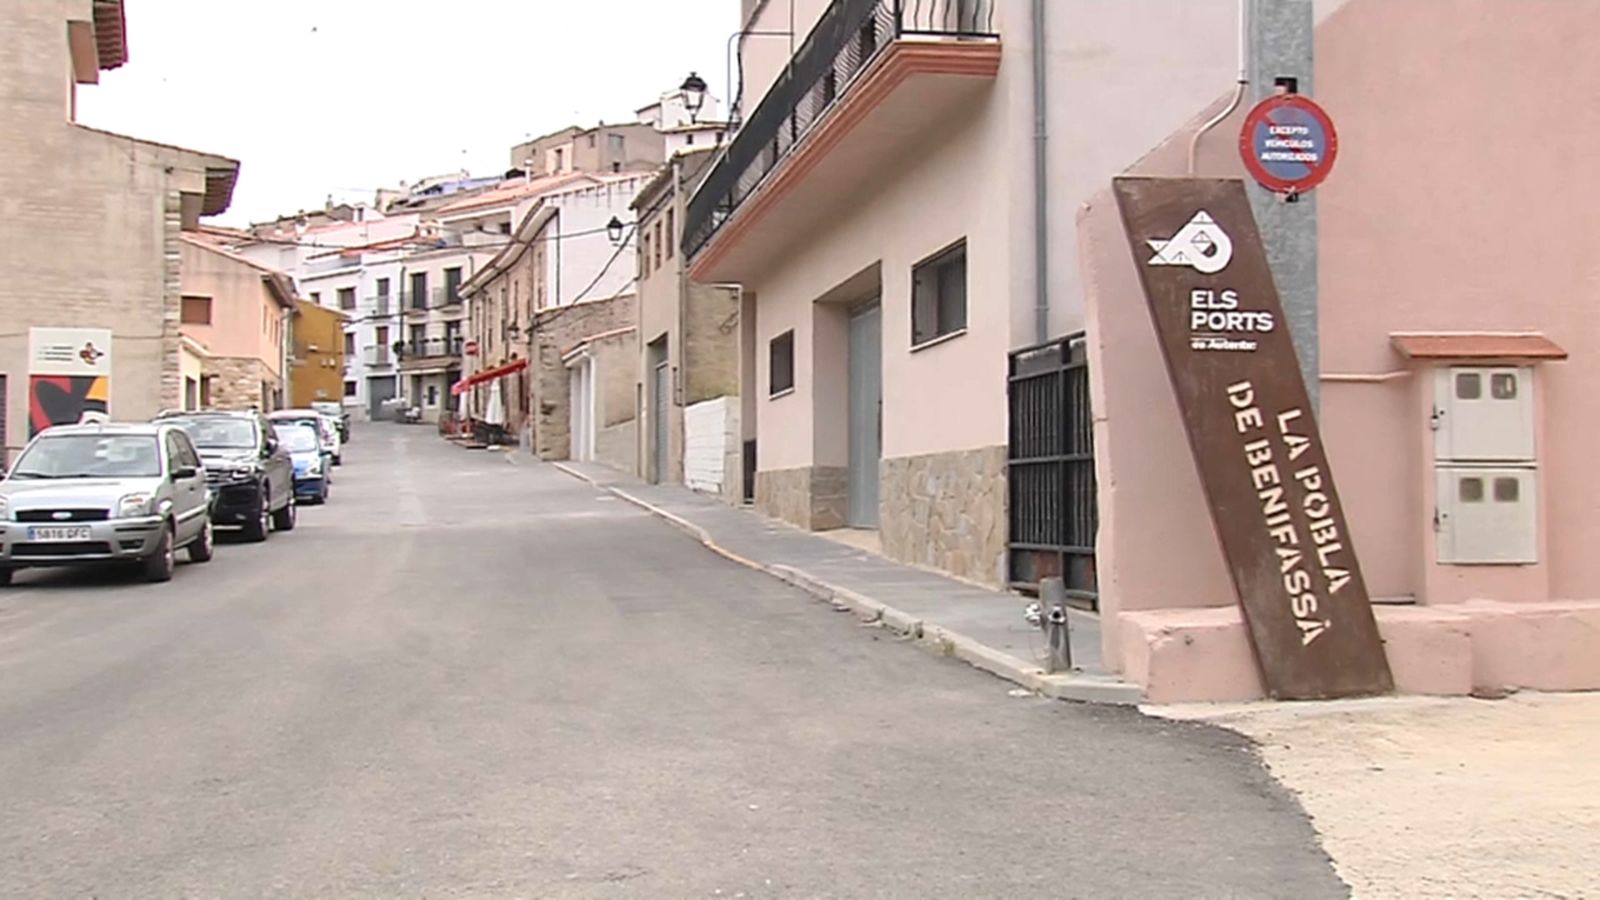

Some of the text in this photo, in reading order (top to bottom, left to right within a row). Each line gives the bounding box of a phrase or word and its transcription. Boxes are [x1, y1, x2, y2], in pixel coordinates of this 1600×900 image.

[1269, 126, 1308, 135] EXCEPTO
[1190, 290, 1237, 309] ELS
[1190, 311, 1274, 331] PORTS
[1226, 380, 1264, 433] DE
[1276, 408, 1352, 595] LA POBLA
